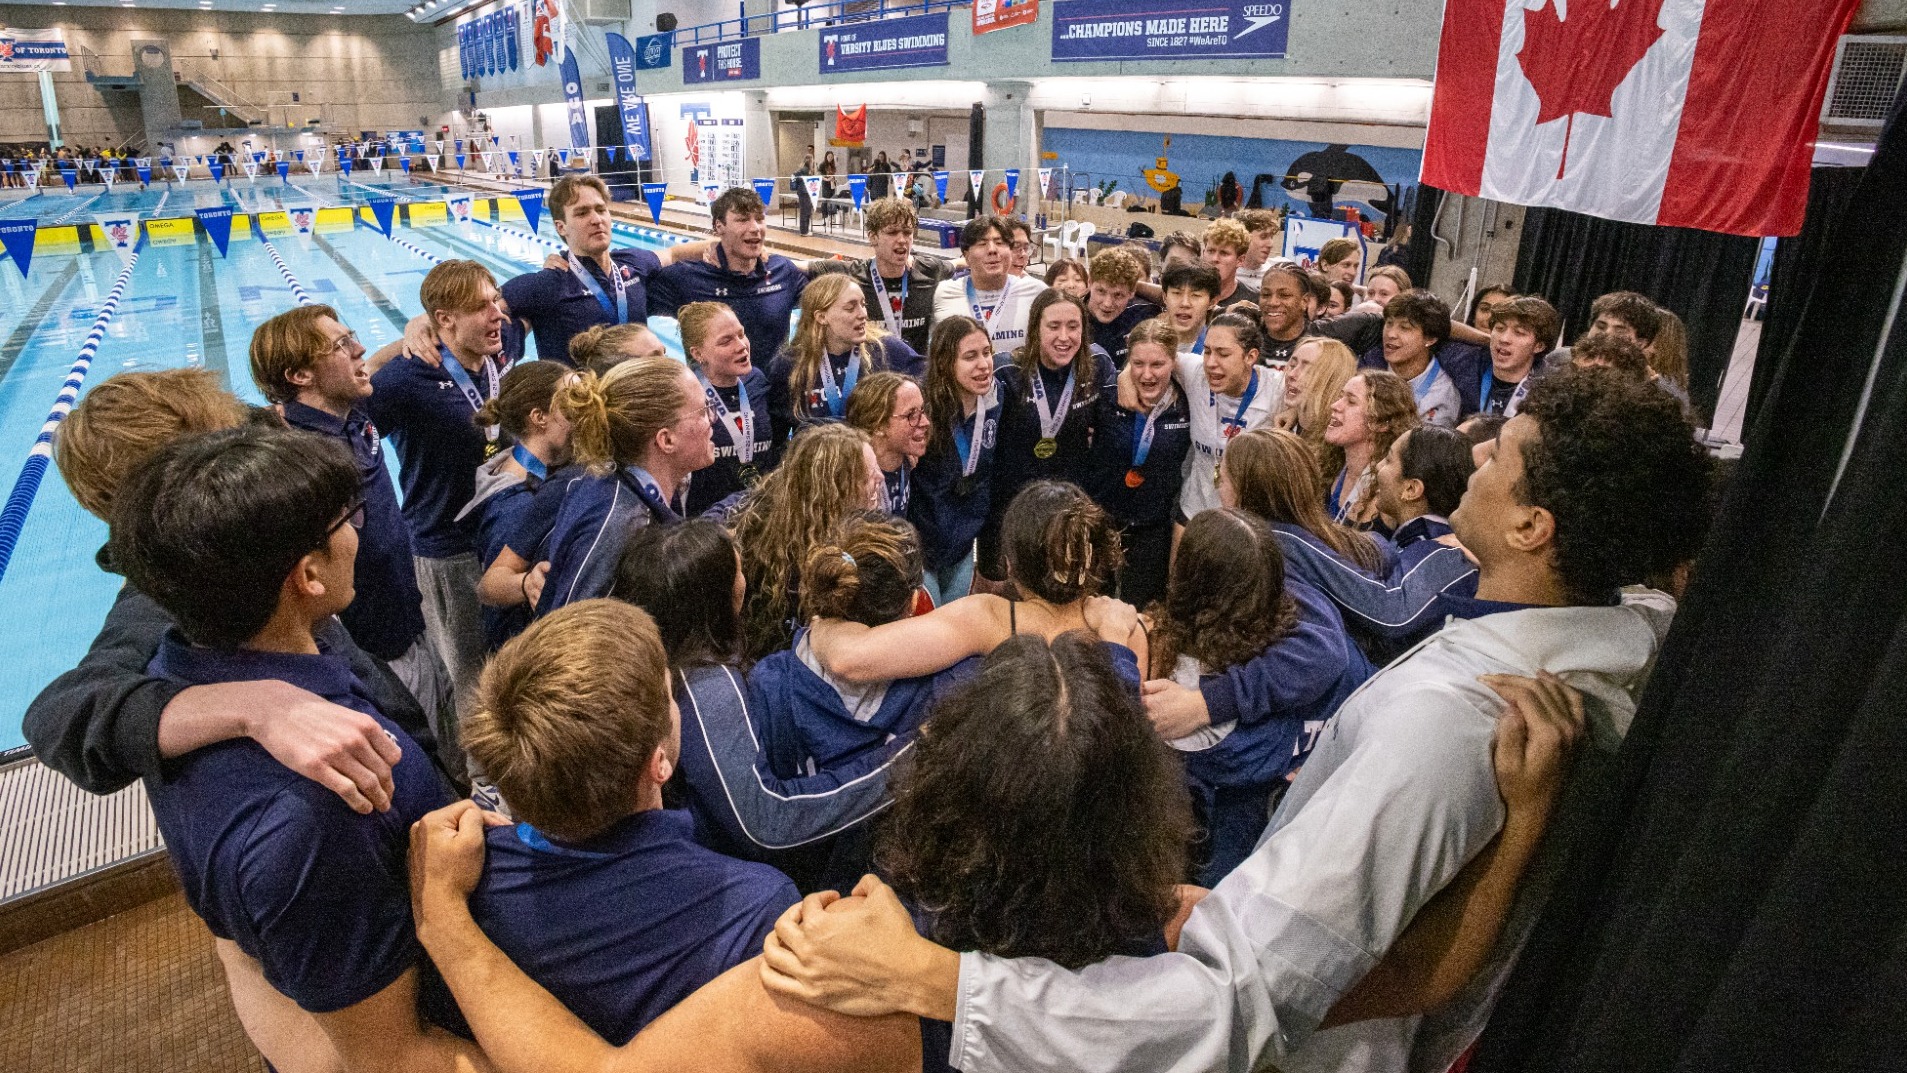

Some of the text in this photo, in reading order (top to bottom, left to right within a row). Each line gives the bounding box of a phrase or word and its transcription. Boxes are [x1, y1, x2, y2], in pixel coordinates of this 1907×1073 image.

[1242, 4, 1283, 17] SPEEDO
[1145, 17, 1187, 36] MADE
[1188, 15, 1229, 34] HERE
[840, 33, 945, 55] VARSITY BLUES SWIMMING
[1147, 35, 1228, 47] SINCE 1827 #WeAreTO
[717, 43, 743, 59] PROTECT
[717, 57, 743, 69] THIS HOUSE
[565, 82, 583, 125] OUA
[517, 192, 542, 200] TORONTO
[198, 210, 232, 219] TORONTO
